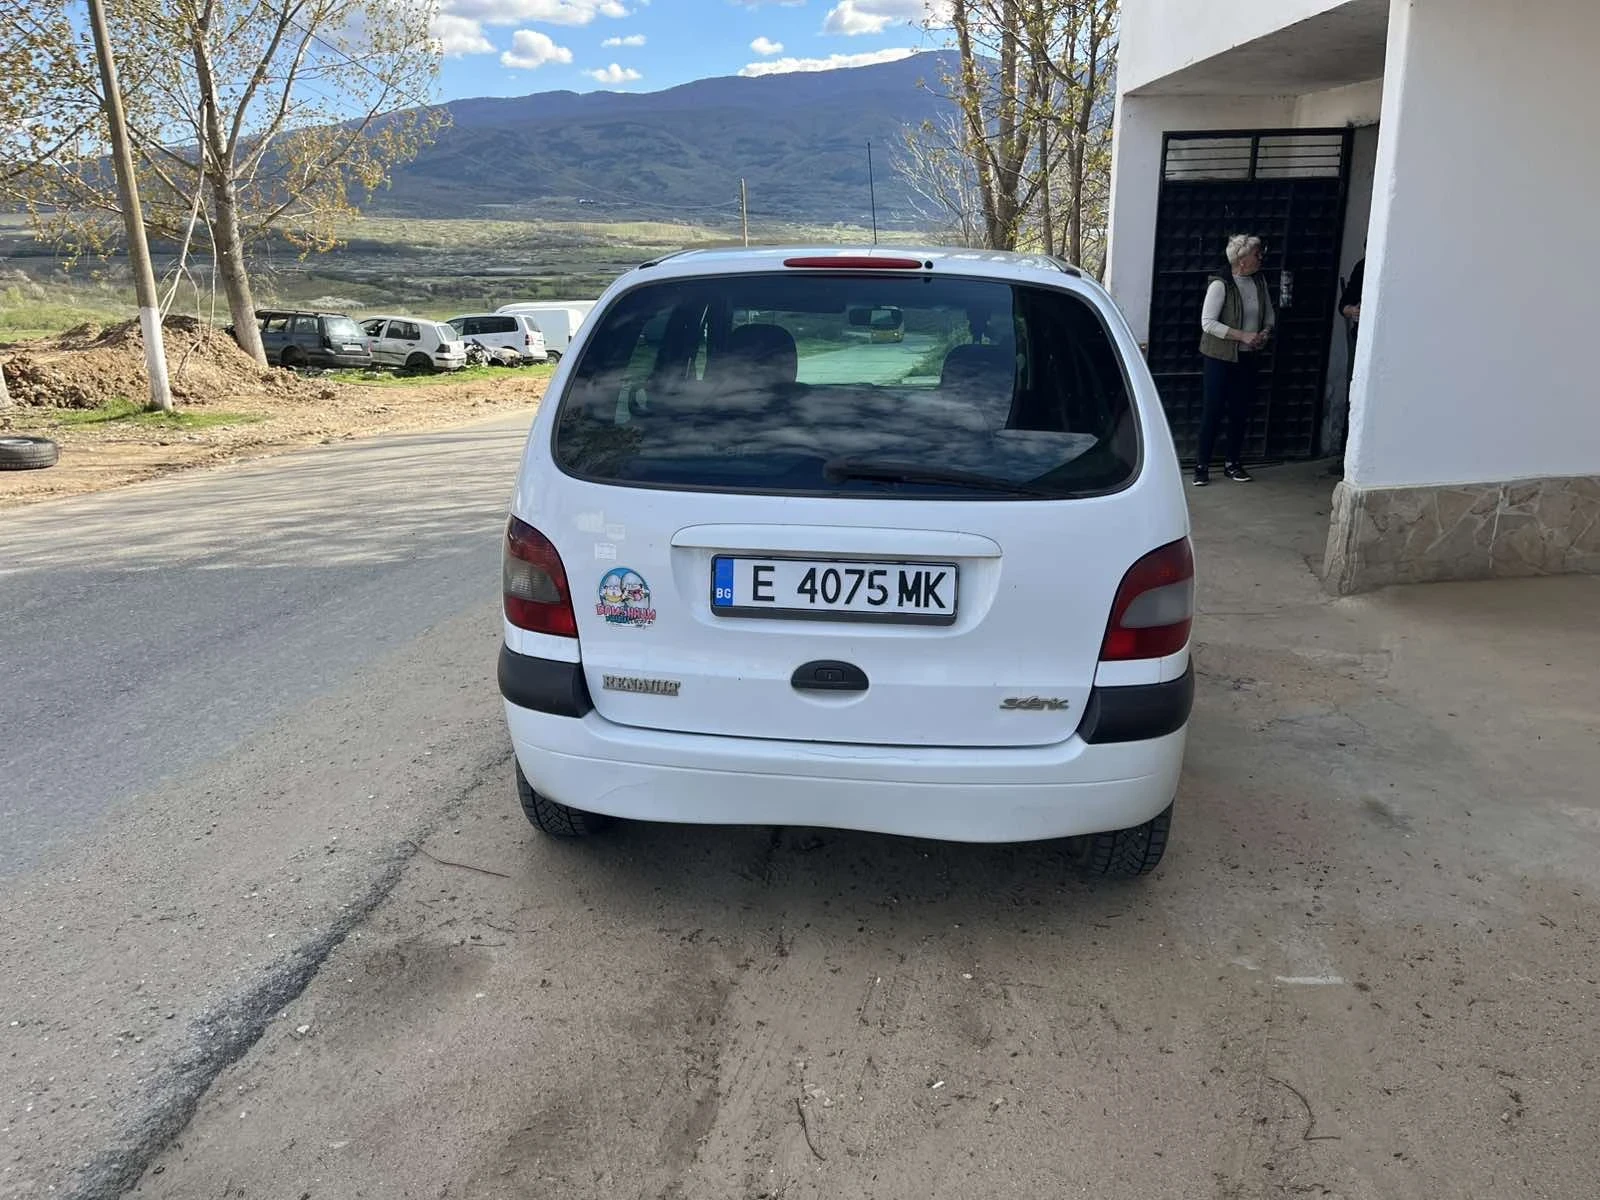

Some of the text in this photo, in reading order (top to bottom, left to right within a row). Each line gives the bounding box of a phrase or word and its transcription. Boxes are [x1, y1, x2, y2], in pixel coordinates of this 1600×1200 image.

[715, 587, 732, 599] BG
[752, 565, 947, 609] E 4075 MK
[602, 673, 681, 697] RENAULT
